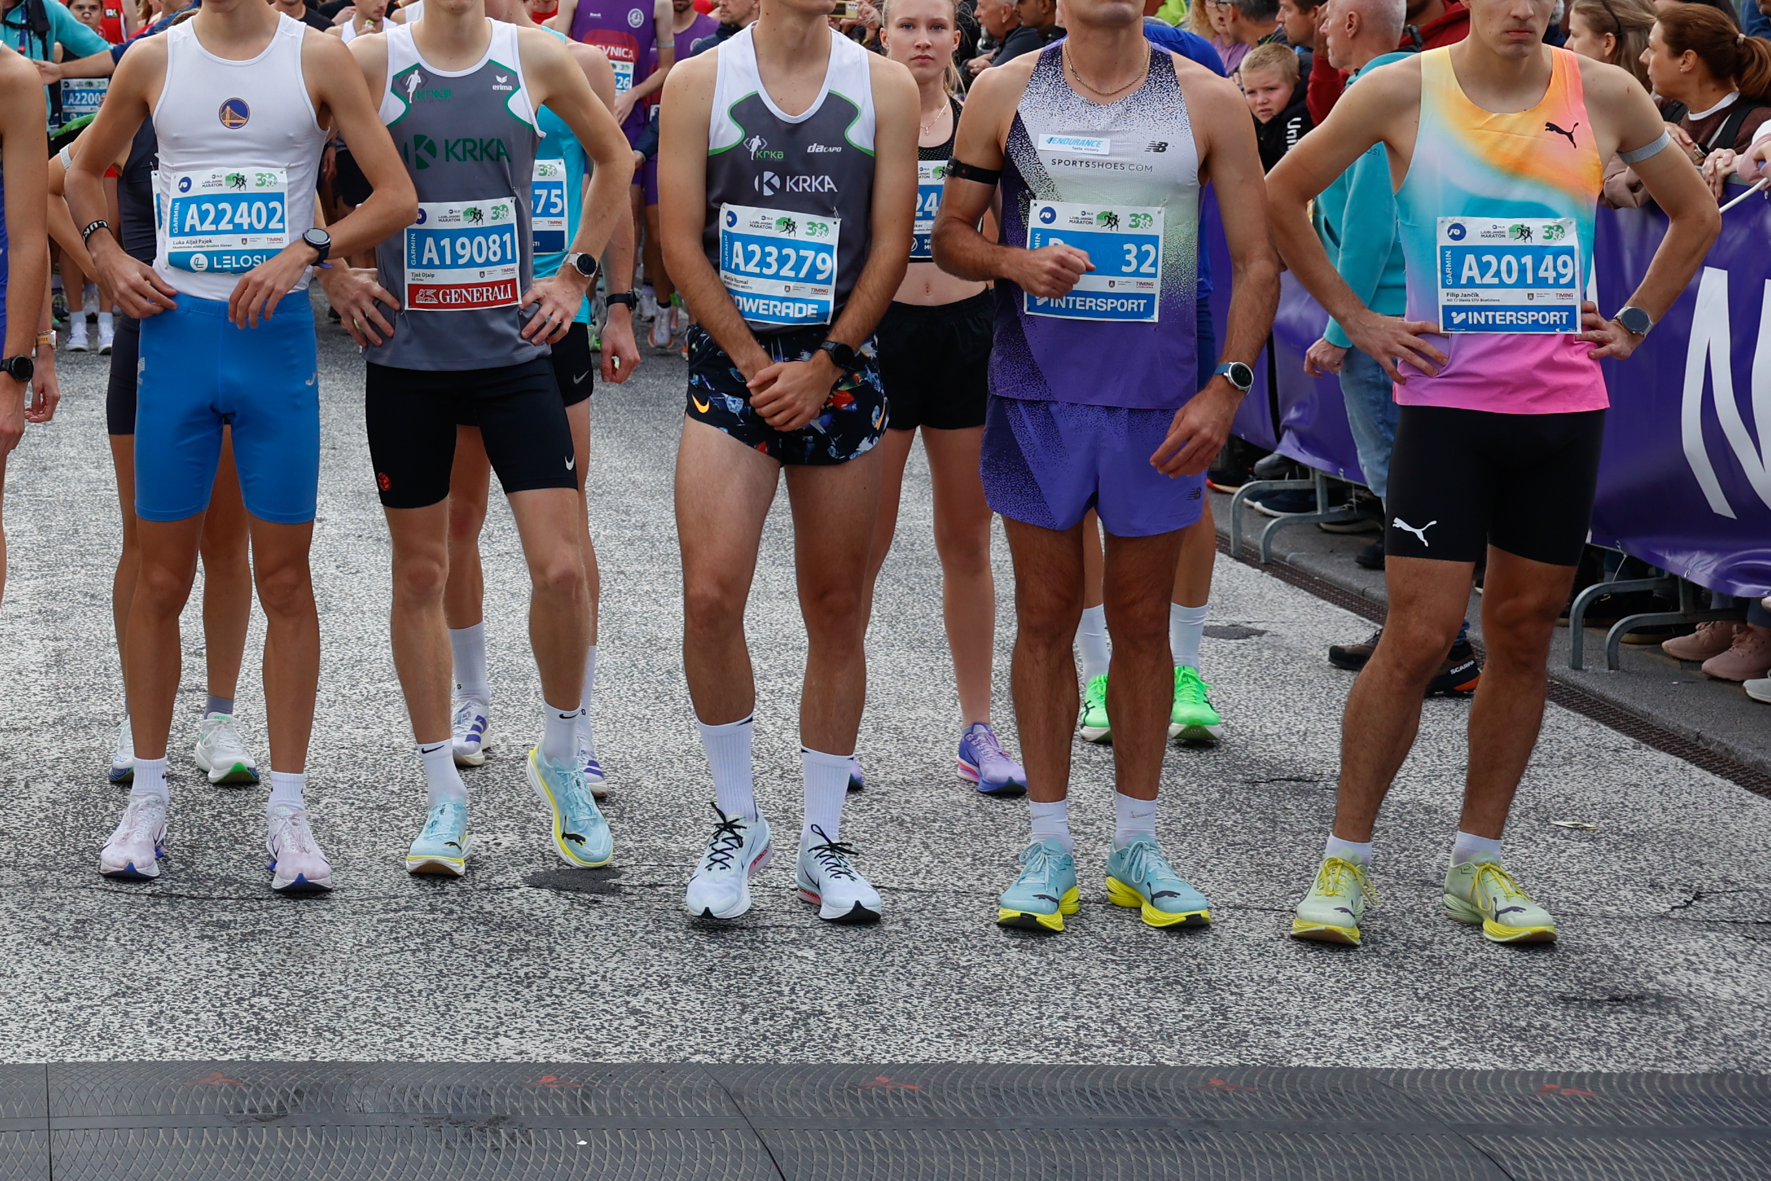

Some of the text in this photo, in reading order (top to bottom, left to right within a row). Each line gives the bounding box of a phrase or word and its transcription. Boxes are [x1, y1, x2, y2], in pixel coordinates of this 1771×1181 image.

[445, 138, 512, 162] KRKA
[786, 175, 838, 192] KRKA
[532, 189, 563, 214] 75
[184, 201, 284, 232] A22402
[422, 233, 512, 265] A19081
[731, 241, 832, 280] A23279
[1460, 254, 1574, 285] A20149
[439, 283, 512, 304] GENERALI
[731, 294, 818, 317] OWERADE
[1050, 296, 1147, 312] INTERSPORT
[1469, 311, 1569, 325] INTERSPORT
